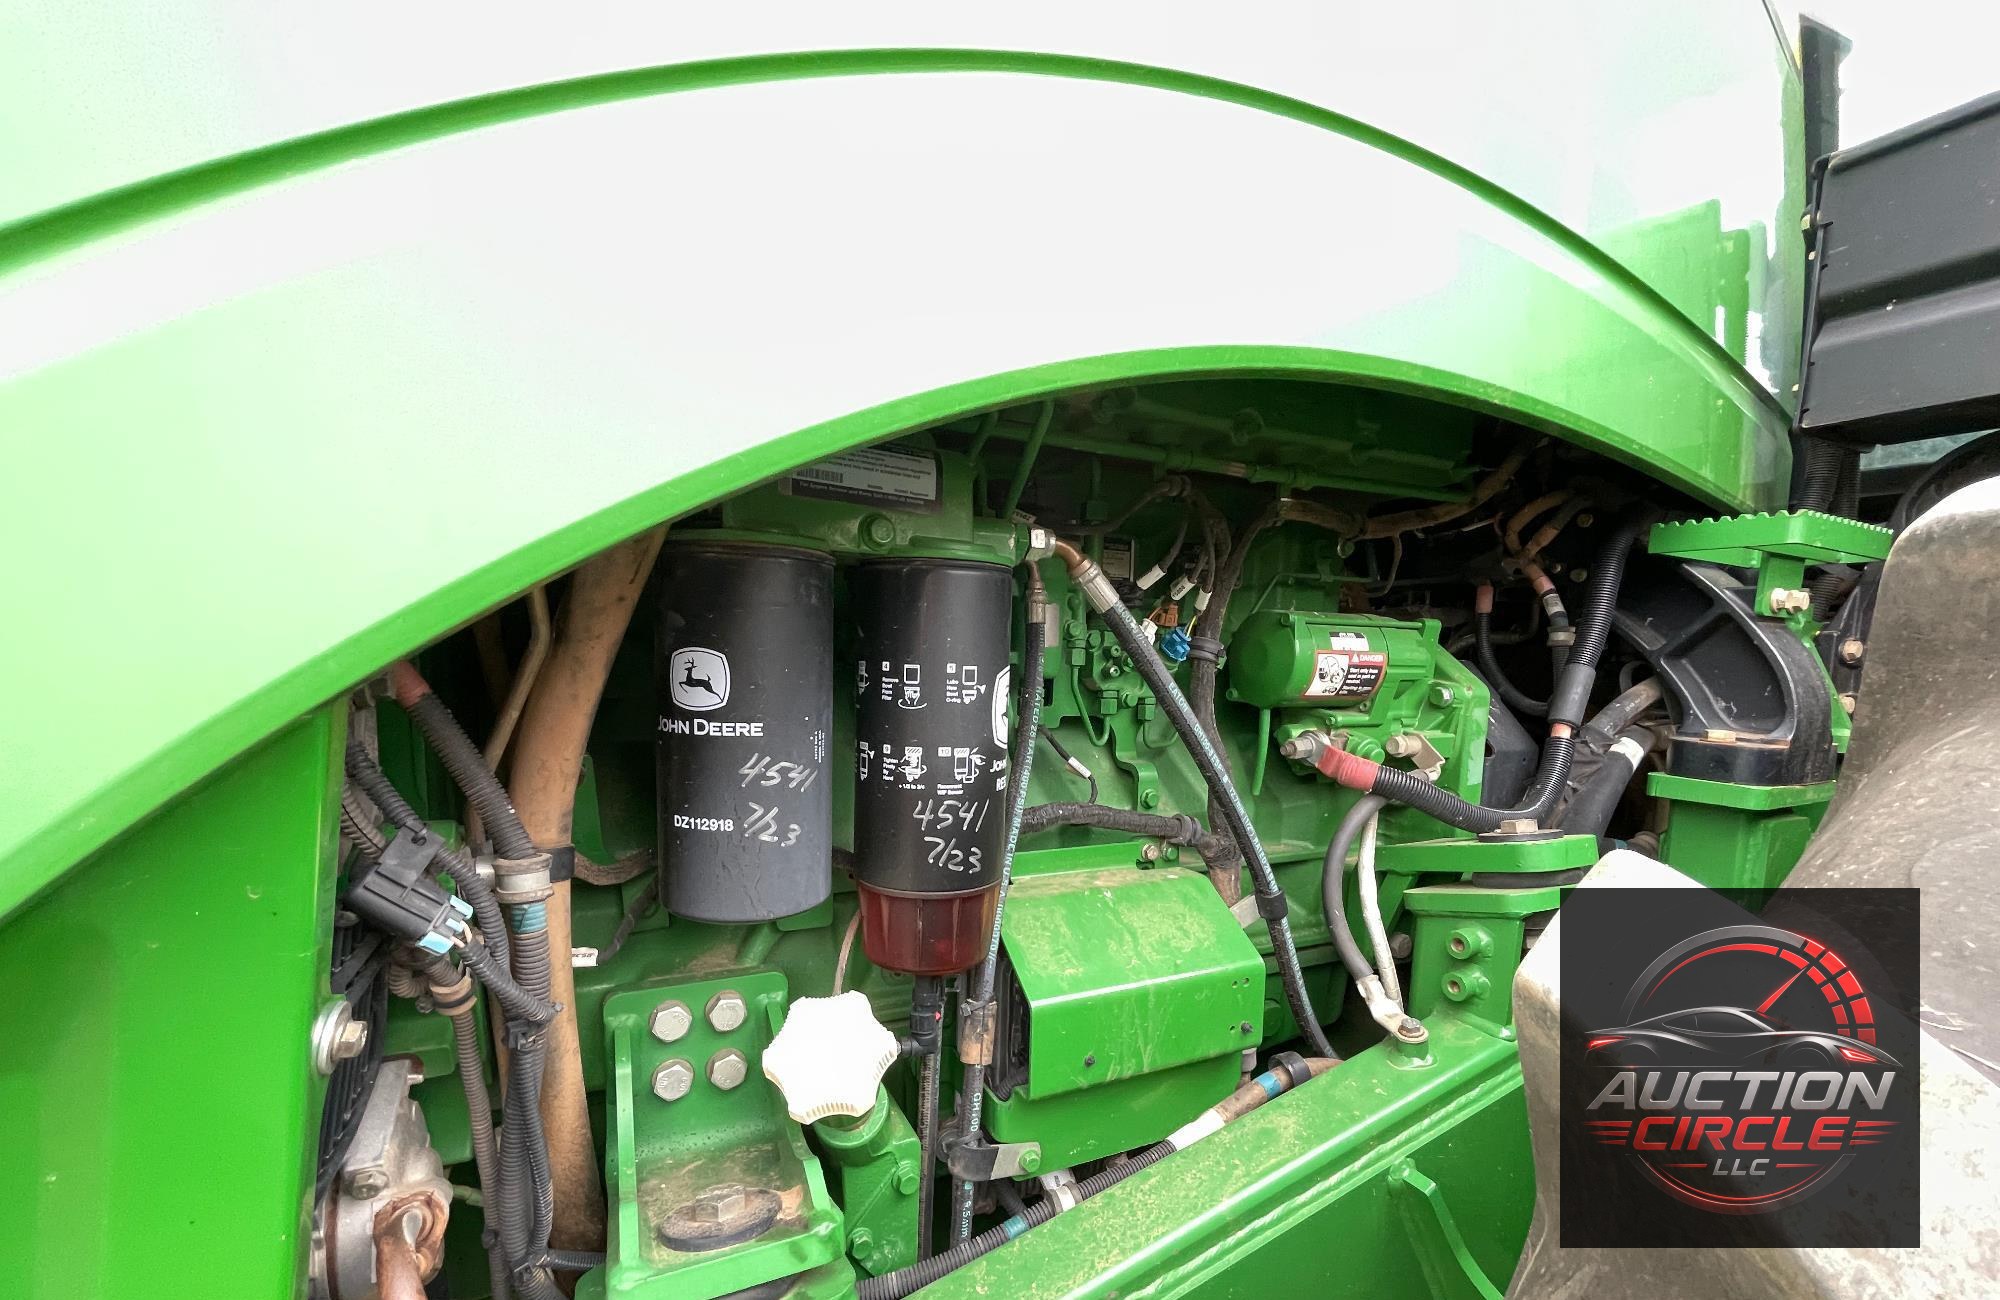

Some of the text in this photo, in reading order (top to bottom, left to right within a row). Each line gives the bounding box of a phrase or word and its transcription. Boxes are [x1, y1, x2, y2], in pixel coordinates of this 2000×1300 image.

[1360, 654, 1383, 662] DANGER
[1167, 680, 1190, 713] EATON
[658, 715, 764, 737] JOHN DEERE
[738, 752, 818, 793] 4541
[674, 814, 734, 832] DZ112918
[913, 798, 991, 833] 4541
[1005, 815, 1022, 851] MADE
[923, 836, 982, 875] 7/23
